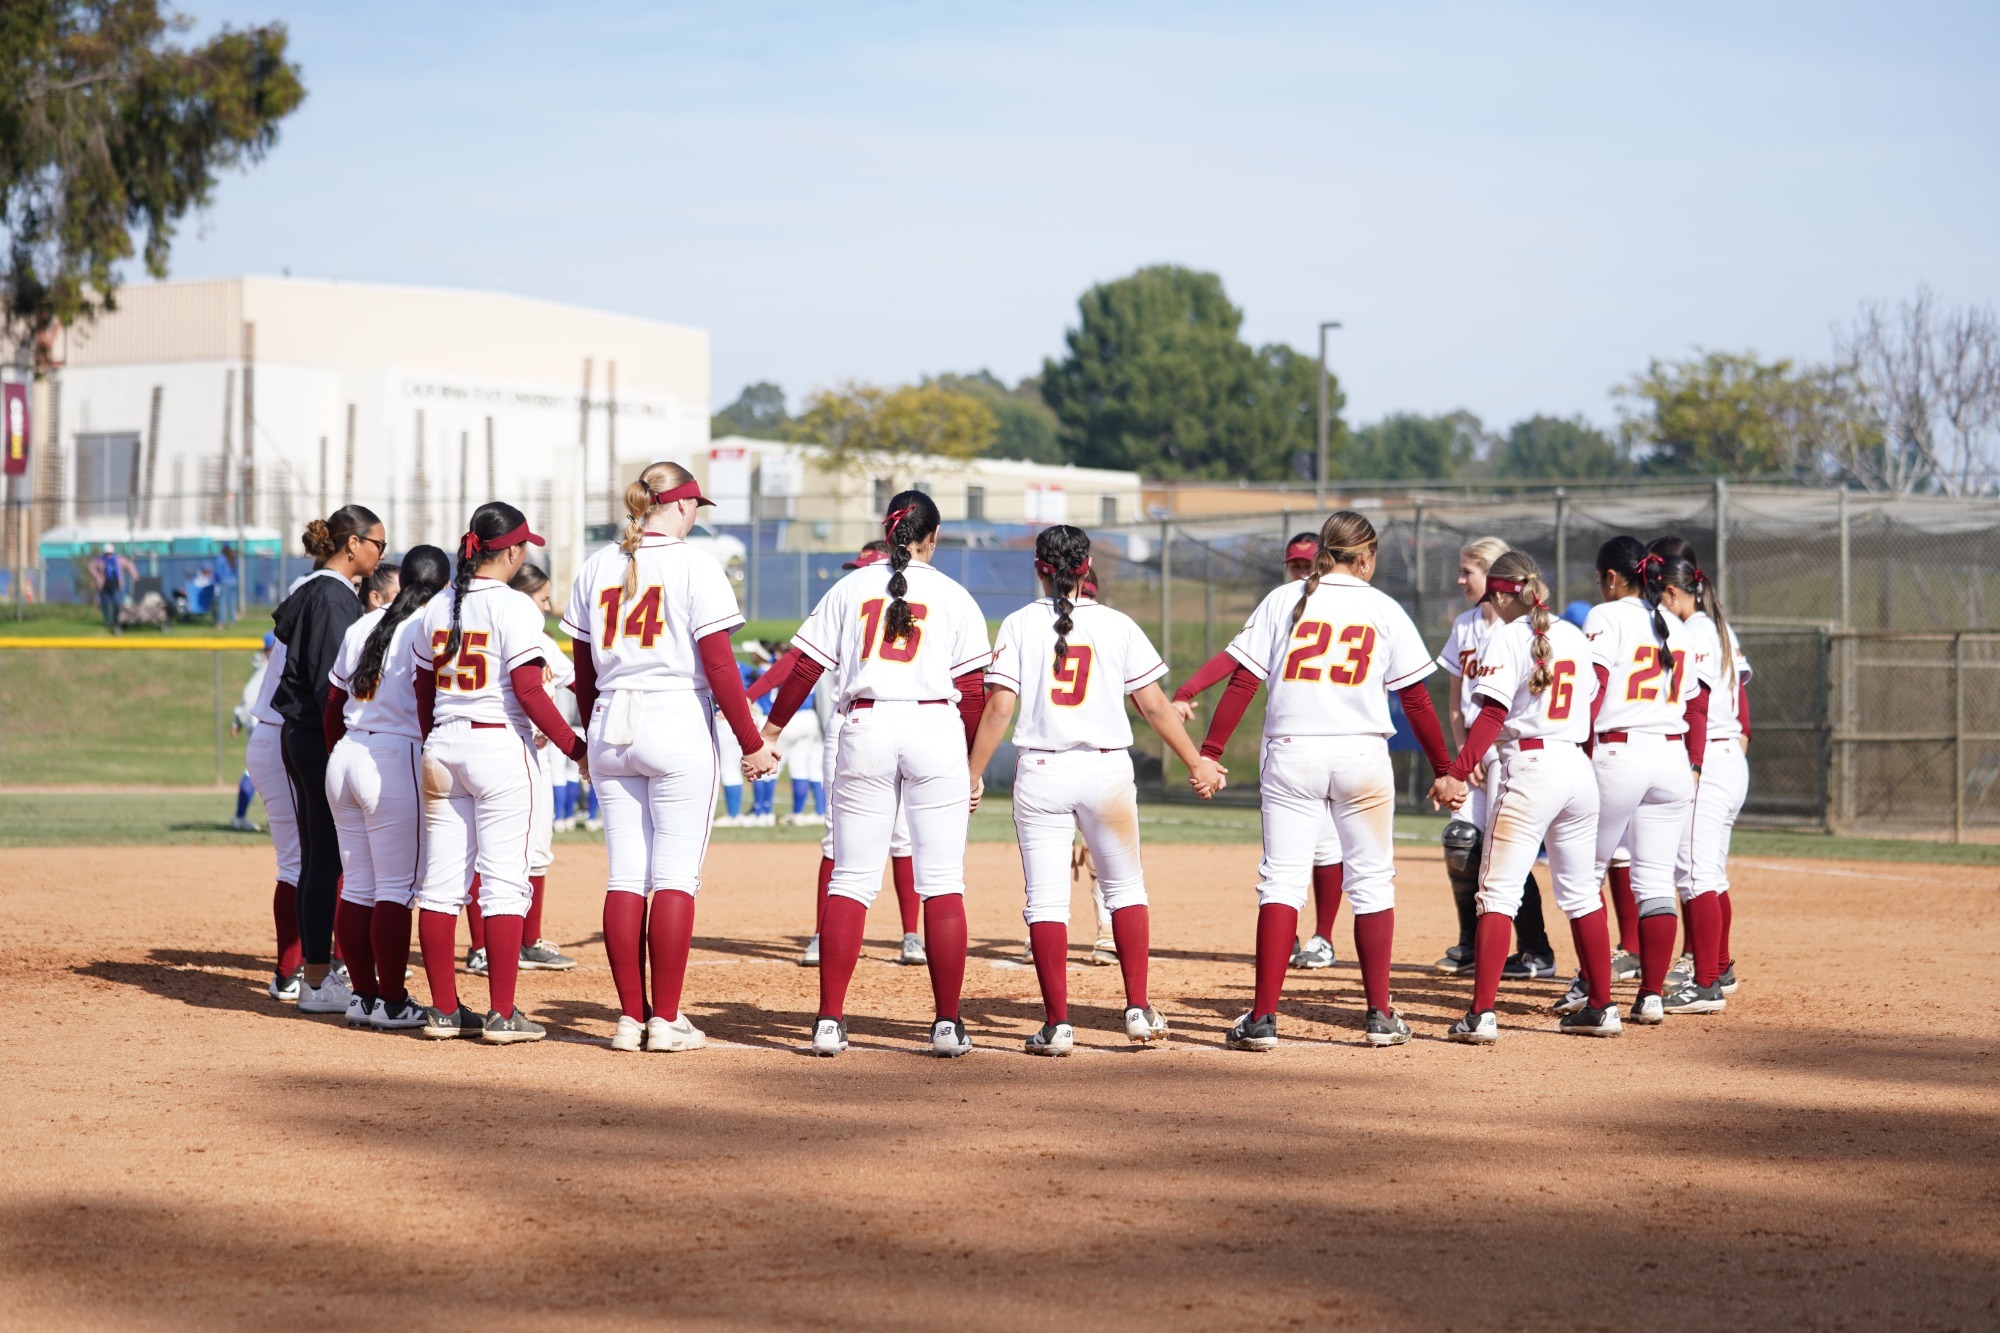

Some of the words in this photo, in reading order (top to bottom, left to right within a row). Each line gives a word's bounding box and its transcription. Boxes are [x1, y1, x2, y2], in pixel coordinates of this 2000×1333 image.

[599, 585, 665, 649] 14
[858, 597, 929, 664] 16
[431, 629, 490, 692] 25
[1050, 644, 1093, 708] 9
[1283, 620, 1376, 687] 23
[1625, 644, 1686, 704] 21
[1547, 659, 1576, 720] 6
